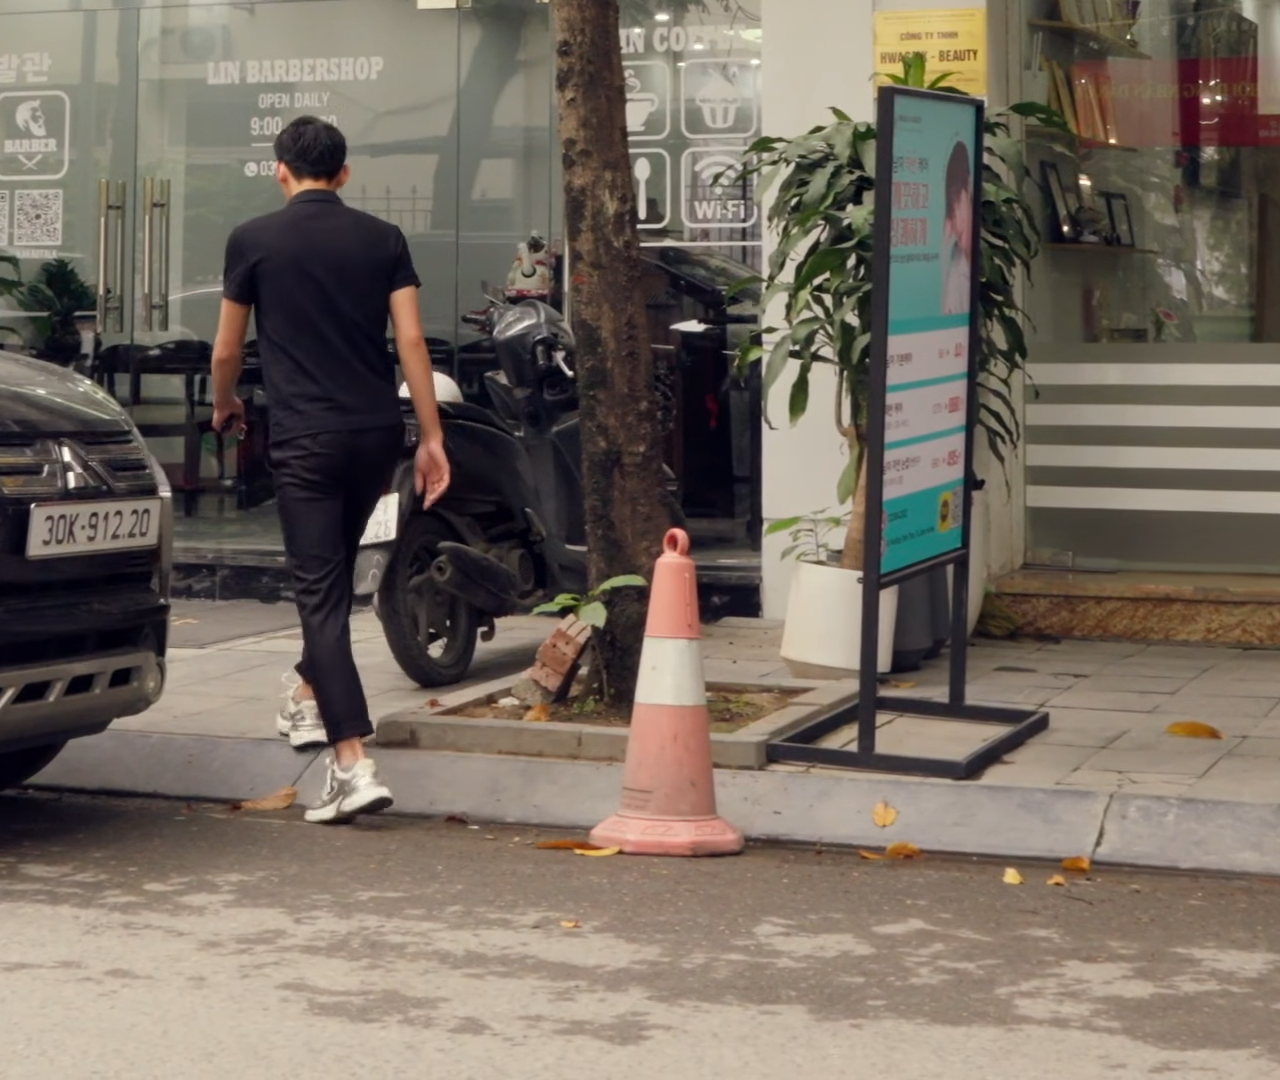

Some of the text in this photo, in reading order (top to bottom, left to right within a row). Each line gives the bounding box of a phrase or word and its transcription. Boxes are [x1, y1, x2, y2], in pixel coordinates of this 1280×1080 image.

[925, 31, 934, 40] TY
[938, 49, 978, 62] BEAUTY
[207, 56, 385, 84] LIN BARBERSHOP
[258, 92, 331, 108] OPEN DAILY
[250, 116, 283, 136] 9:00
[4, 138, 58, 153] BARBER
[694, 200, 745, 221] Wi-Fi
